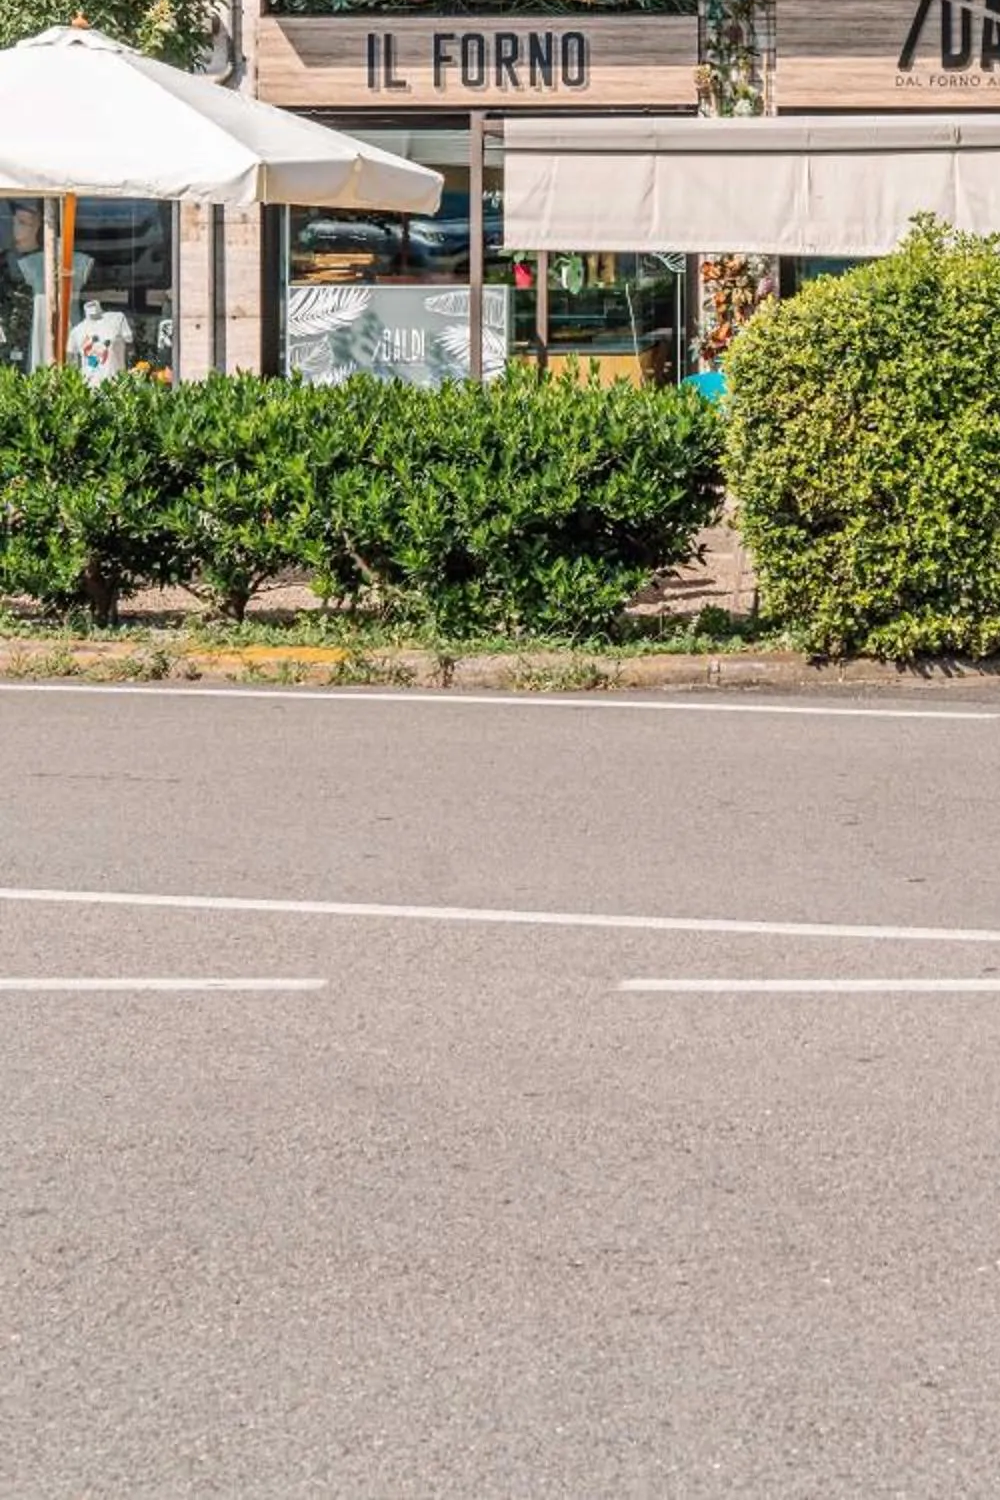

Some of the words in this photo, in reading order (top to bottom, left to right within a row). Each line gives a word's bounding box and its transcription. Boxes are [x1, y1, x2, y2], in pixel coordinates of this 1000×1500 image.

[367, 33, 408, 90] IL
[433, 31, 588, 90] FORNO
[895, 75, 922, 87] DAL
[929, 75, 981, 87] FORNO
